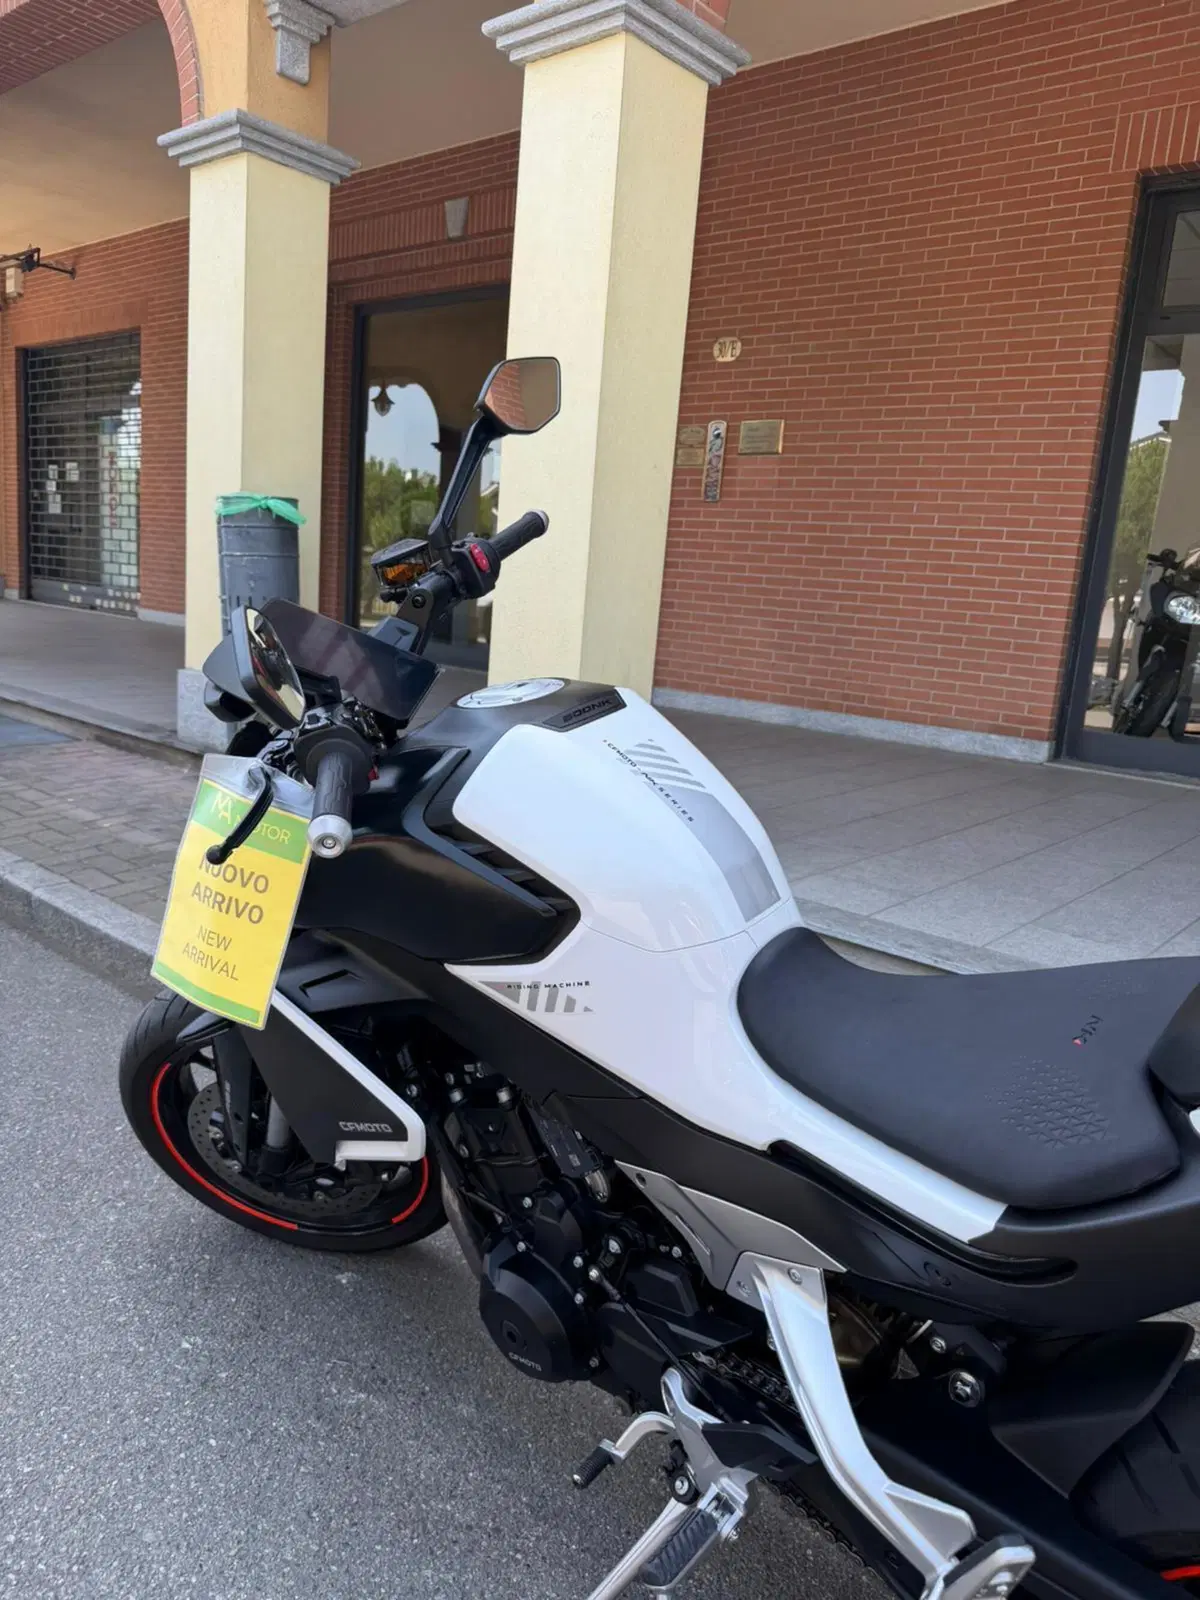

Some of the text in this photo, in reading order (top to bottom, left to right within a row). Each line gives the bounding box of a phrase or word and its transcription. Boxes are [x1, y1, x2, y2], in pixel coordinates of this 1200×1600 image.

[607, 743, 637, 768] CFMOTO
[191, 880, 264, 924] ARRIVO
[197, 926, 233, 951] NEW
[182, 942, 239, 981] ARRIVAL
[544, 980, 590, 989] MACHINE
[338, 1121, 394, 1133] CFMOTO
